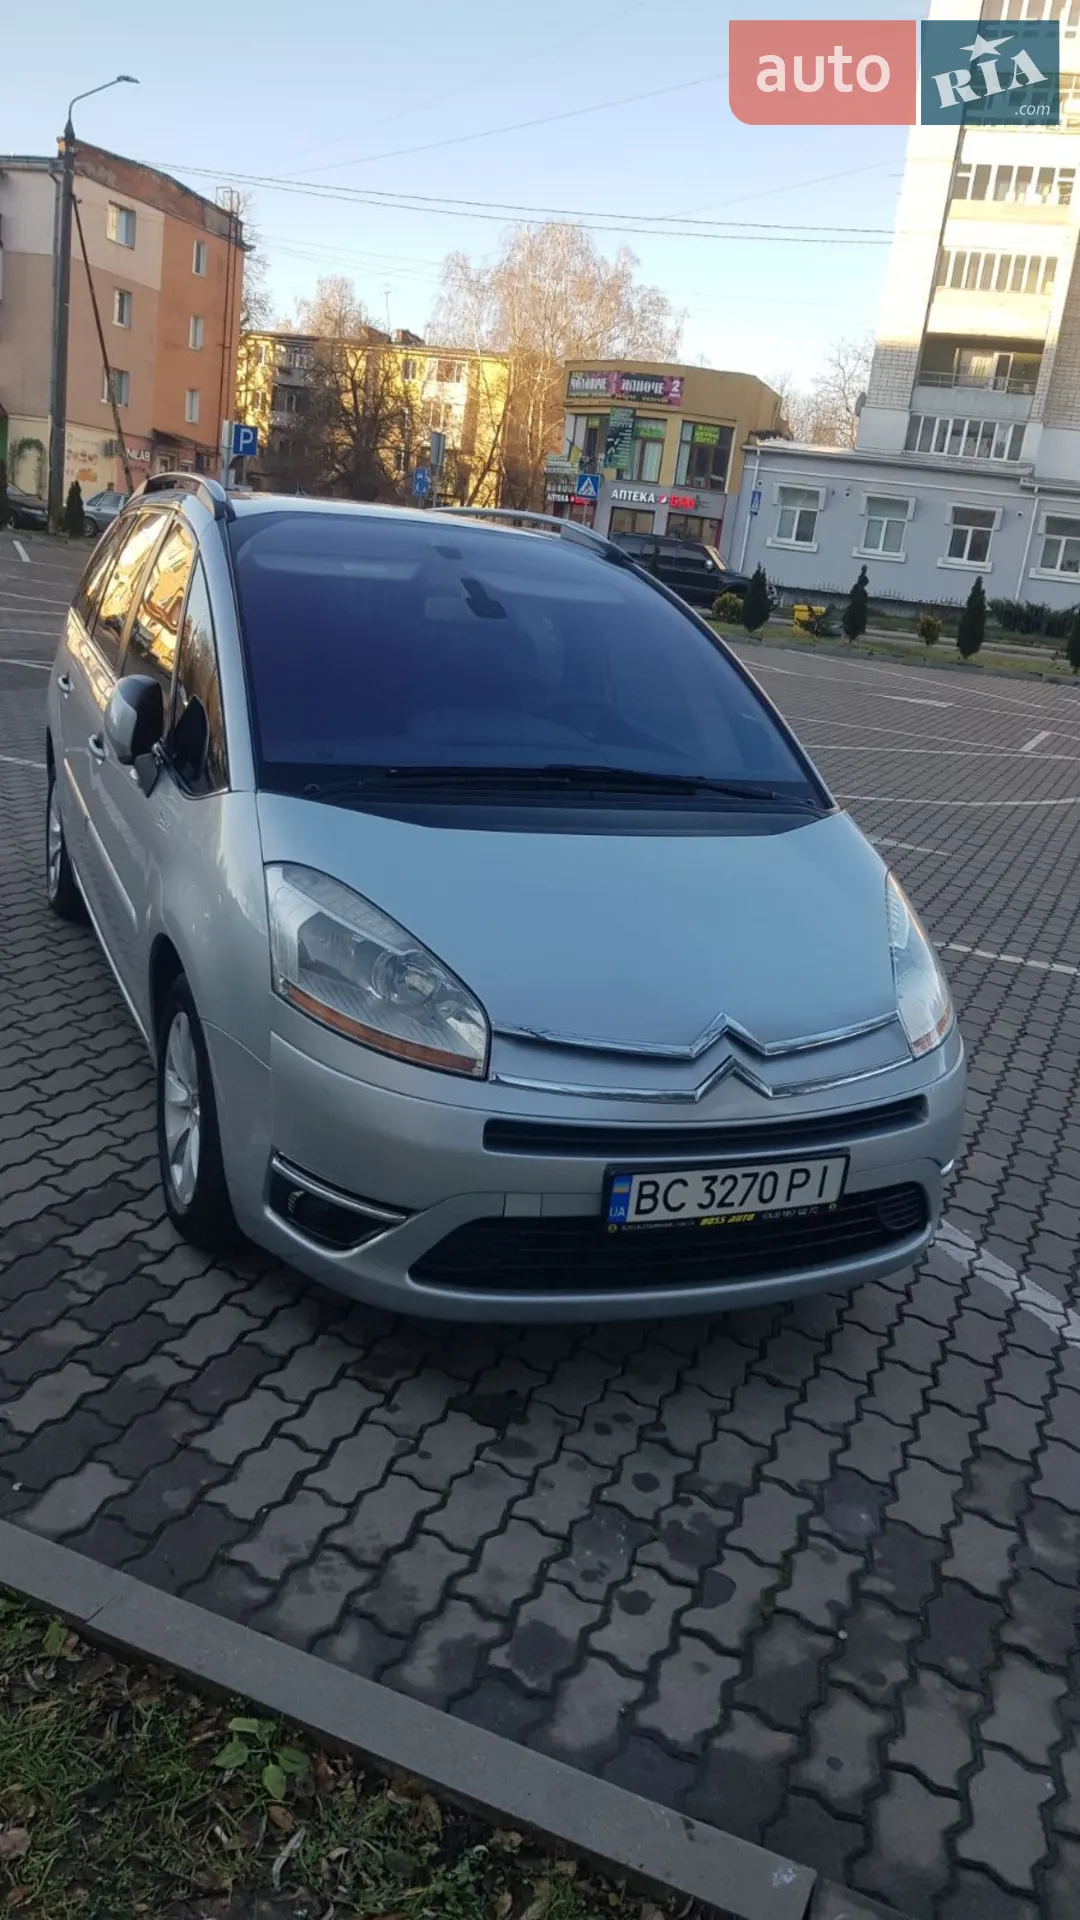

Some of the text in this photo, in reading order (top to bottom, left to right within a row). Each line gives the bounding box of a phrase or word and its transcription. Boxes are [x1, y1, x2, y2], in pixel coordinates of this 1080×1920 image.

[671, 379, 681, 392] 2
[239, 427, 254, 452] P
[610, 488, 656, 504] АПТЕКА
[634, 1164, 829, 1216] BC 3270 PI
[609, 1206, 627, 1218] UA
